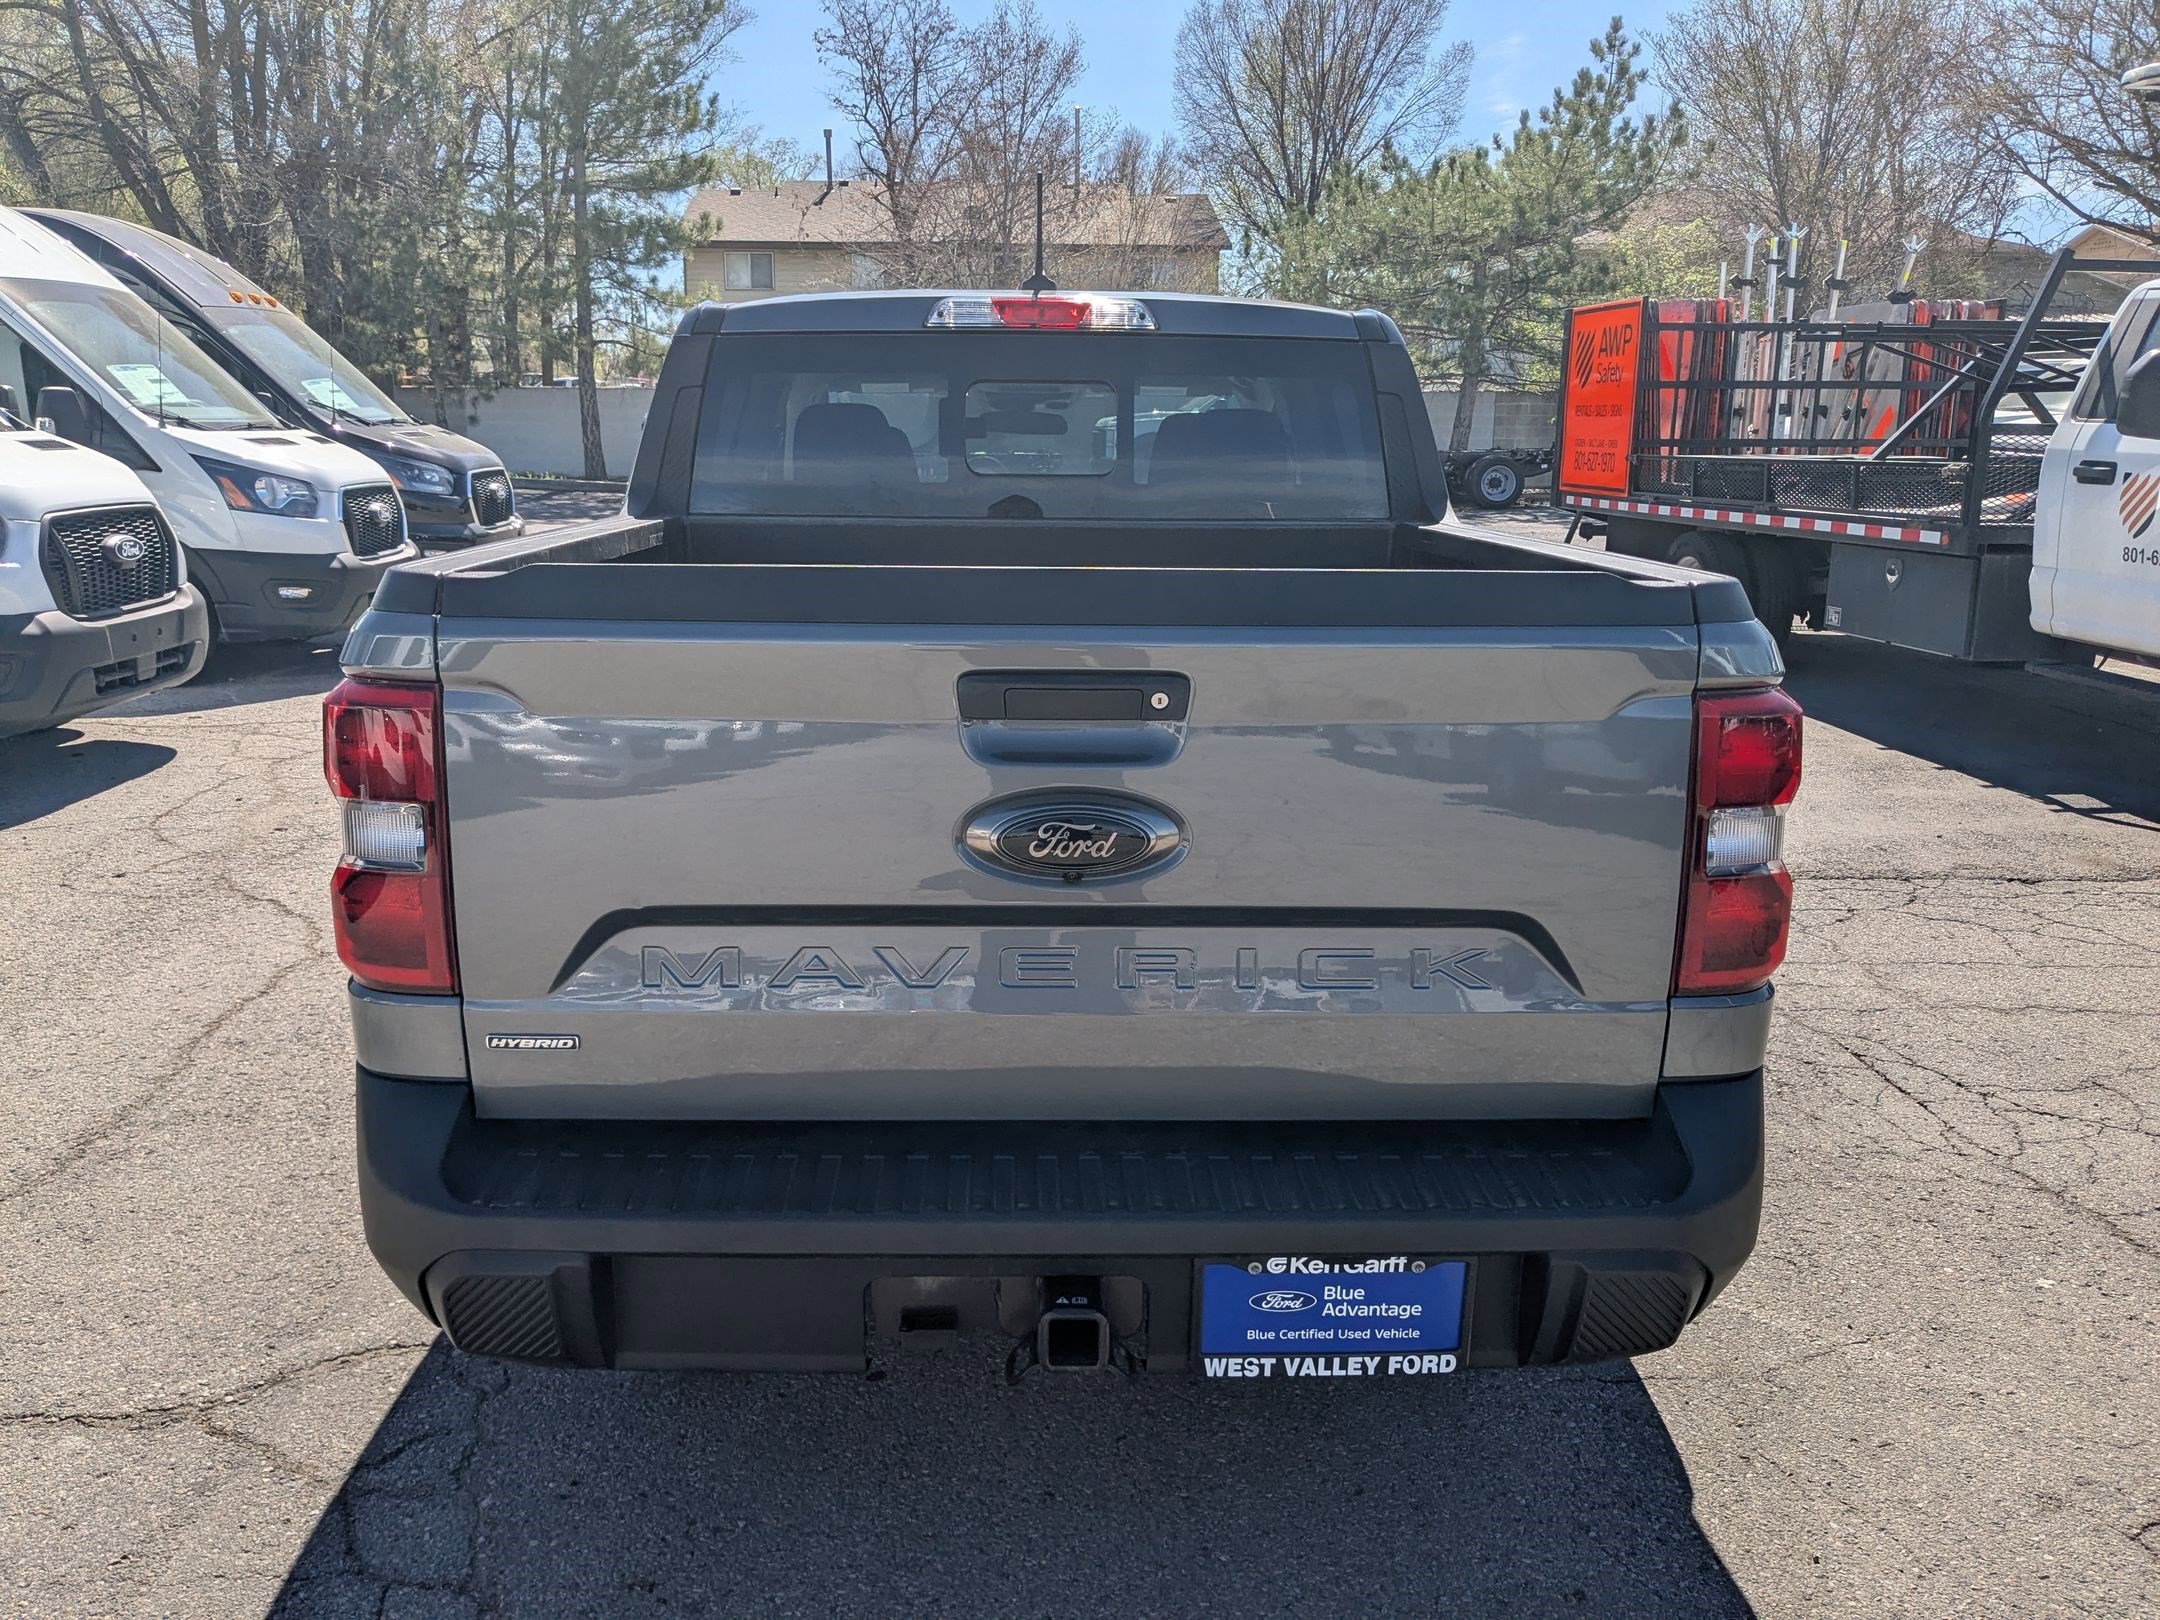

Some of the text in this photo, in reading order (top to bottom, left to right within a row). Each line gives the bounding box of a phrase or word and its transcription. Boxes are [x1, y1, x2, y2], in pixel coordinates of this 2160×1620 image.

[1598, 324, 1633, 358] AWP
[1596, 361, 1624, 388] Safety
[121, 541, 140, 557] Ford
[2122, 546, 2160, 566] 801-6
[1028, 821, 1118, 858] Ford
[641, 945, 1493, 990] MAVERICK
[490, 1038, 574, 1049] HYBRID
[1261, 1294, 1303, 1310] Ford
[1323, 1286, 1366, 1300] Blue
[1322, 1303, 1423, 1319] Advantage
[1246, 1328, 1421, 1341] Blue Certified Used Vehicle
[1204, 1354, 1458, 1378] WEST VALLEY FORD
